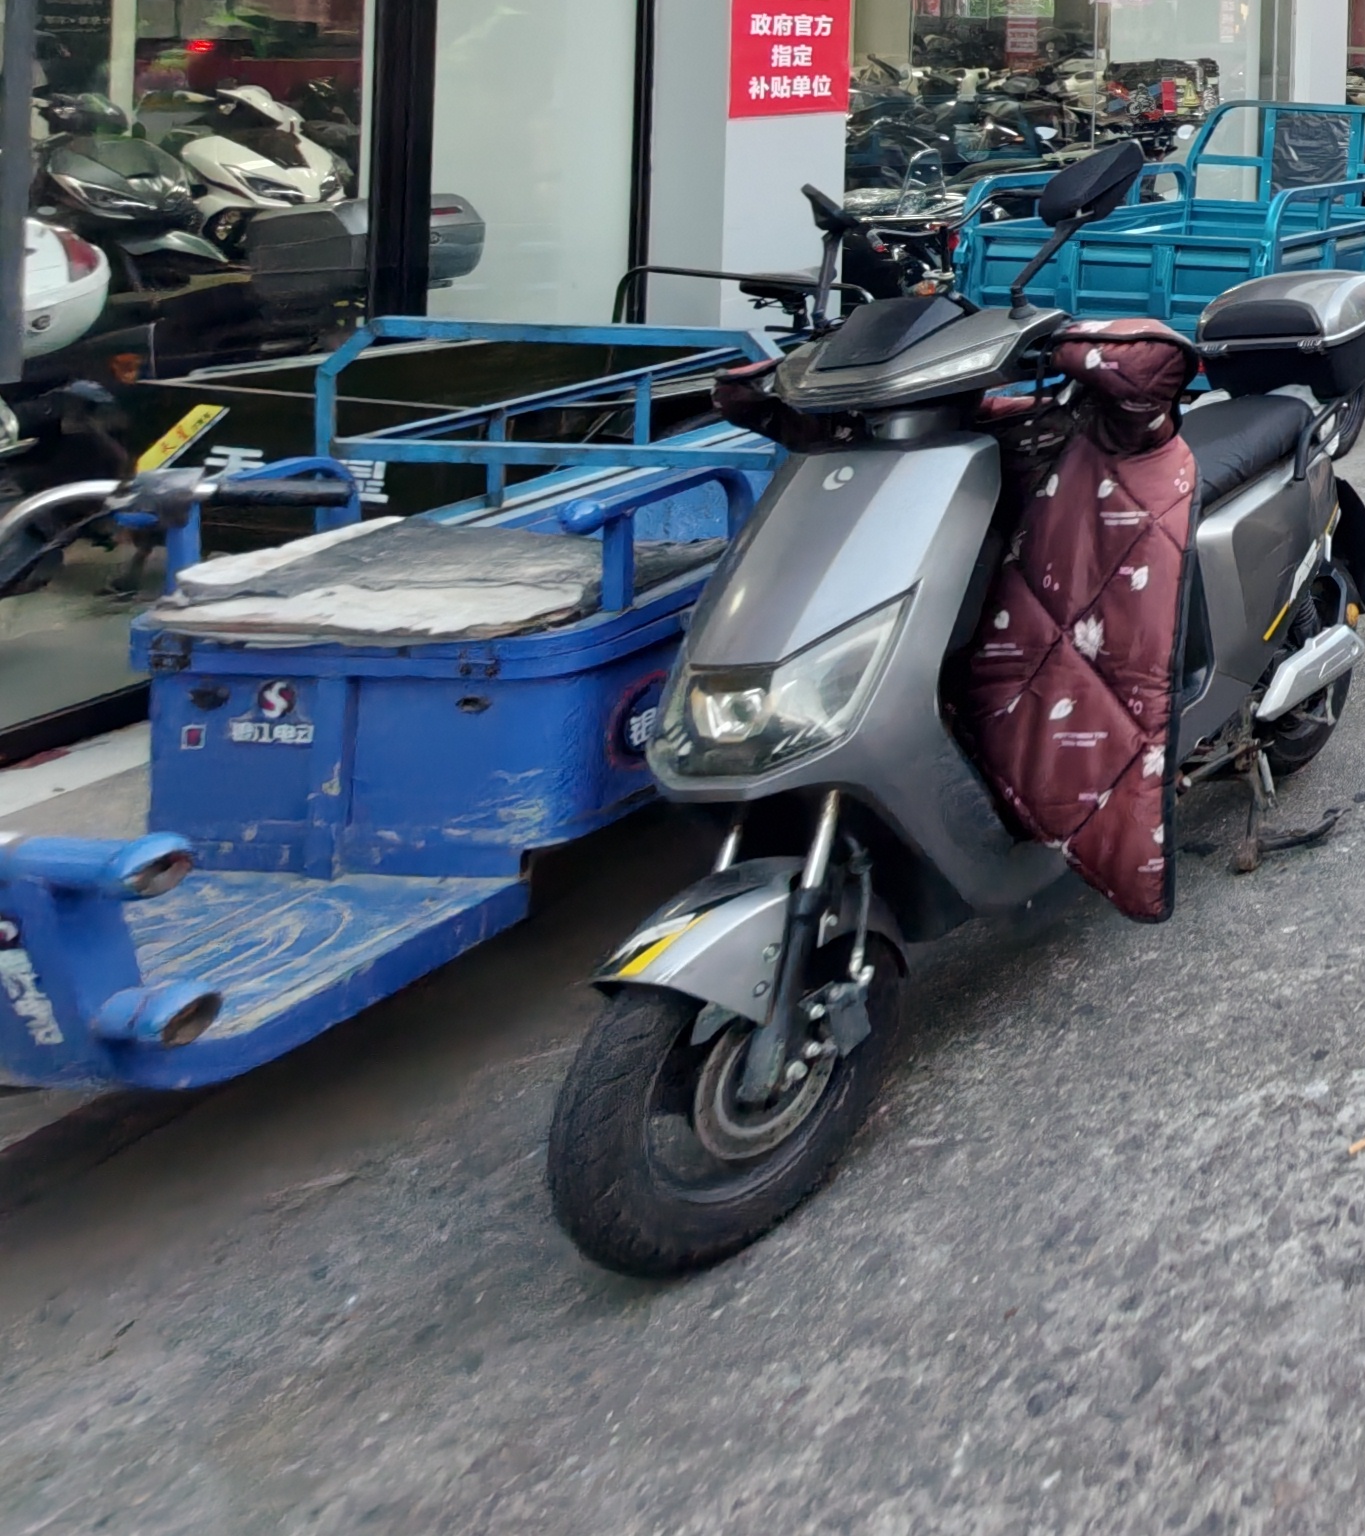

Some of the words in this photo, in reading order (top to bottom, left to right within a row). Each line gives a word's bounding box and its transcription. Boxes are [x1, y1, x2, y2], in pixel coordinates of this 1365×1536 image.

[750, 13, 833, 37] 政府官方
[771, 44, 812, 68] 指定
[749, 75, 832, 100] 补贴单位
